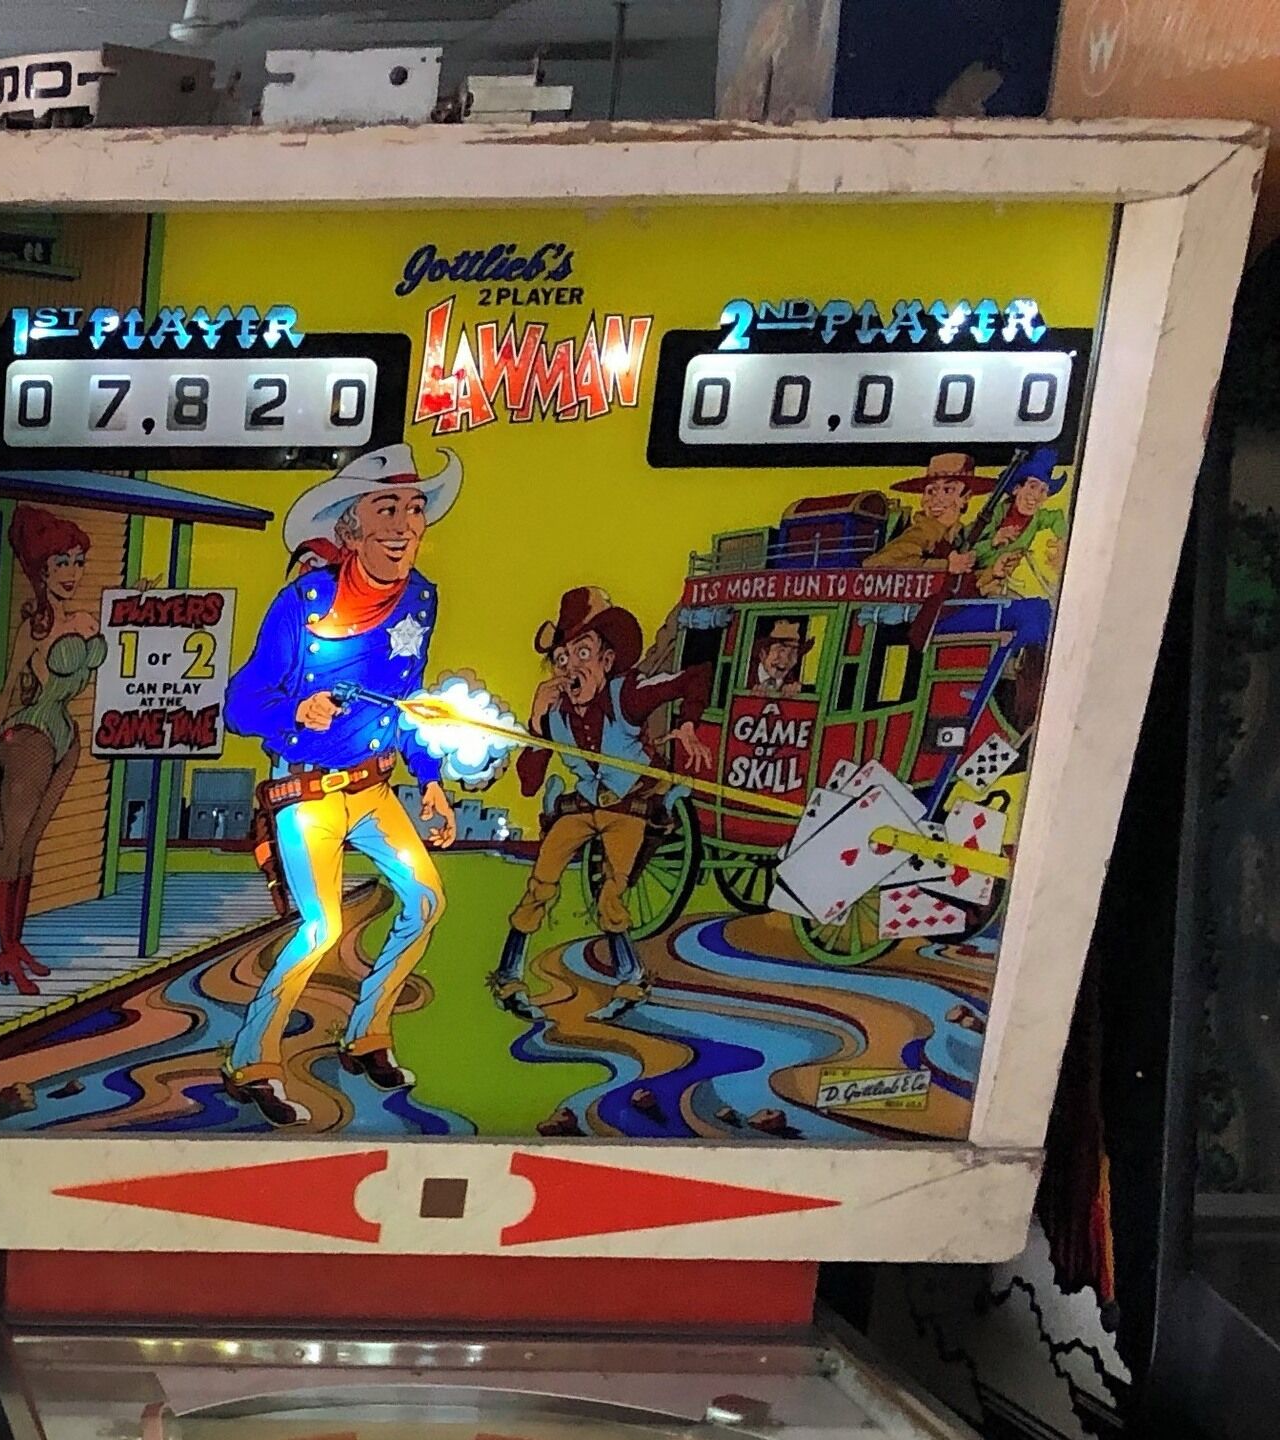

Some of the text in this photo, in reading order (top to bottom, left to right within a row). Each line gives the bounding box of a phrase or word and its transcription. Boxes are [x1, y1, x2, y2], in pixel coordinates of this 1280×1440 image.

[396, 242, 575, 297] Gottlieb's
[479, 286, 585, 305] 2 PLAYER
[11, 304, 306, 355] 1ST PLAYER
[820, 298, 1047, 345] PLAYER
[412, 294, 652, 435] LAWMAN
[727, 576, 777, 598] MORE
[783, 574, 821, 597] FUN
[827, 575, 847, 596] TO
[853, 573, 935, 598] COMPETE
[108, 592, 225, 628] PLAYERS
[119, 630, 217, 679] 1 or 2
[126, 682, 202, 695] CAN PLAY
[139, 697, 183, 707] AT THE
[95, 703, 220, 750] SAME TIME
[763, 703, 780, 716] A
[734, 716, 812, 749] GAME
[728, 756, 803, 793] SKILL
